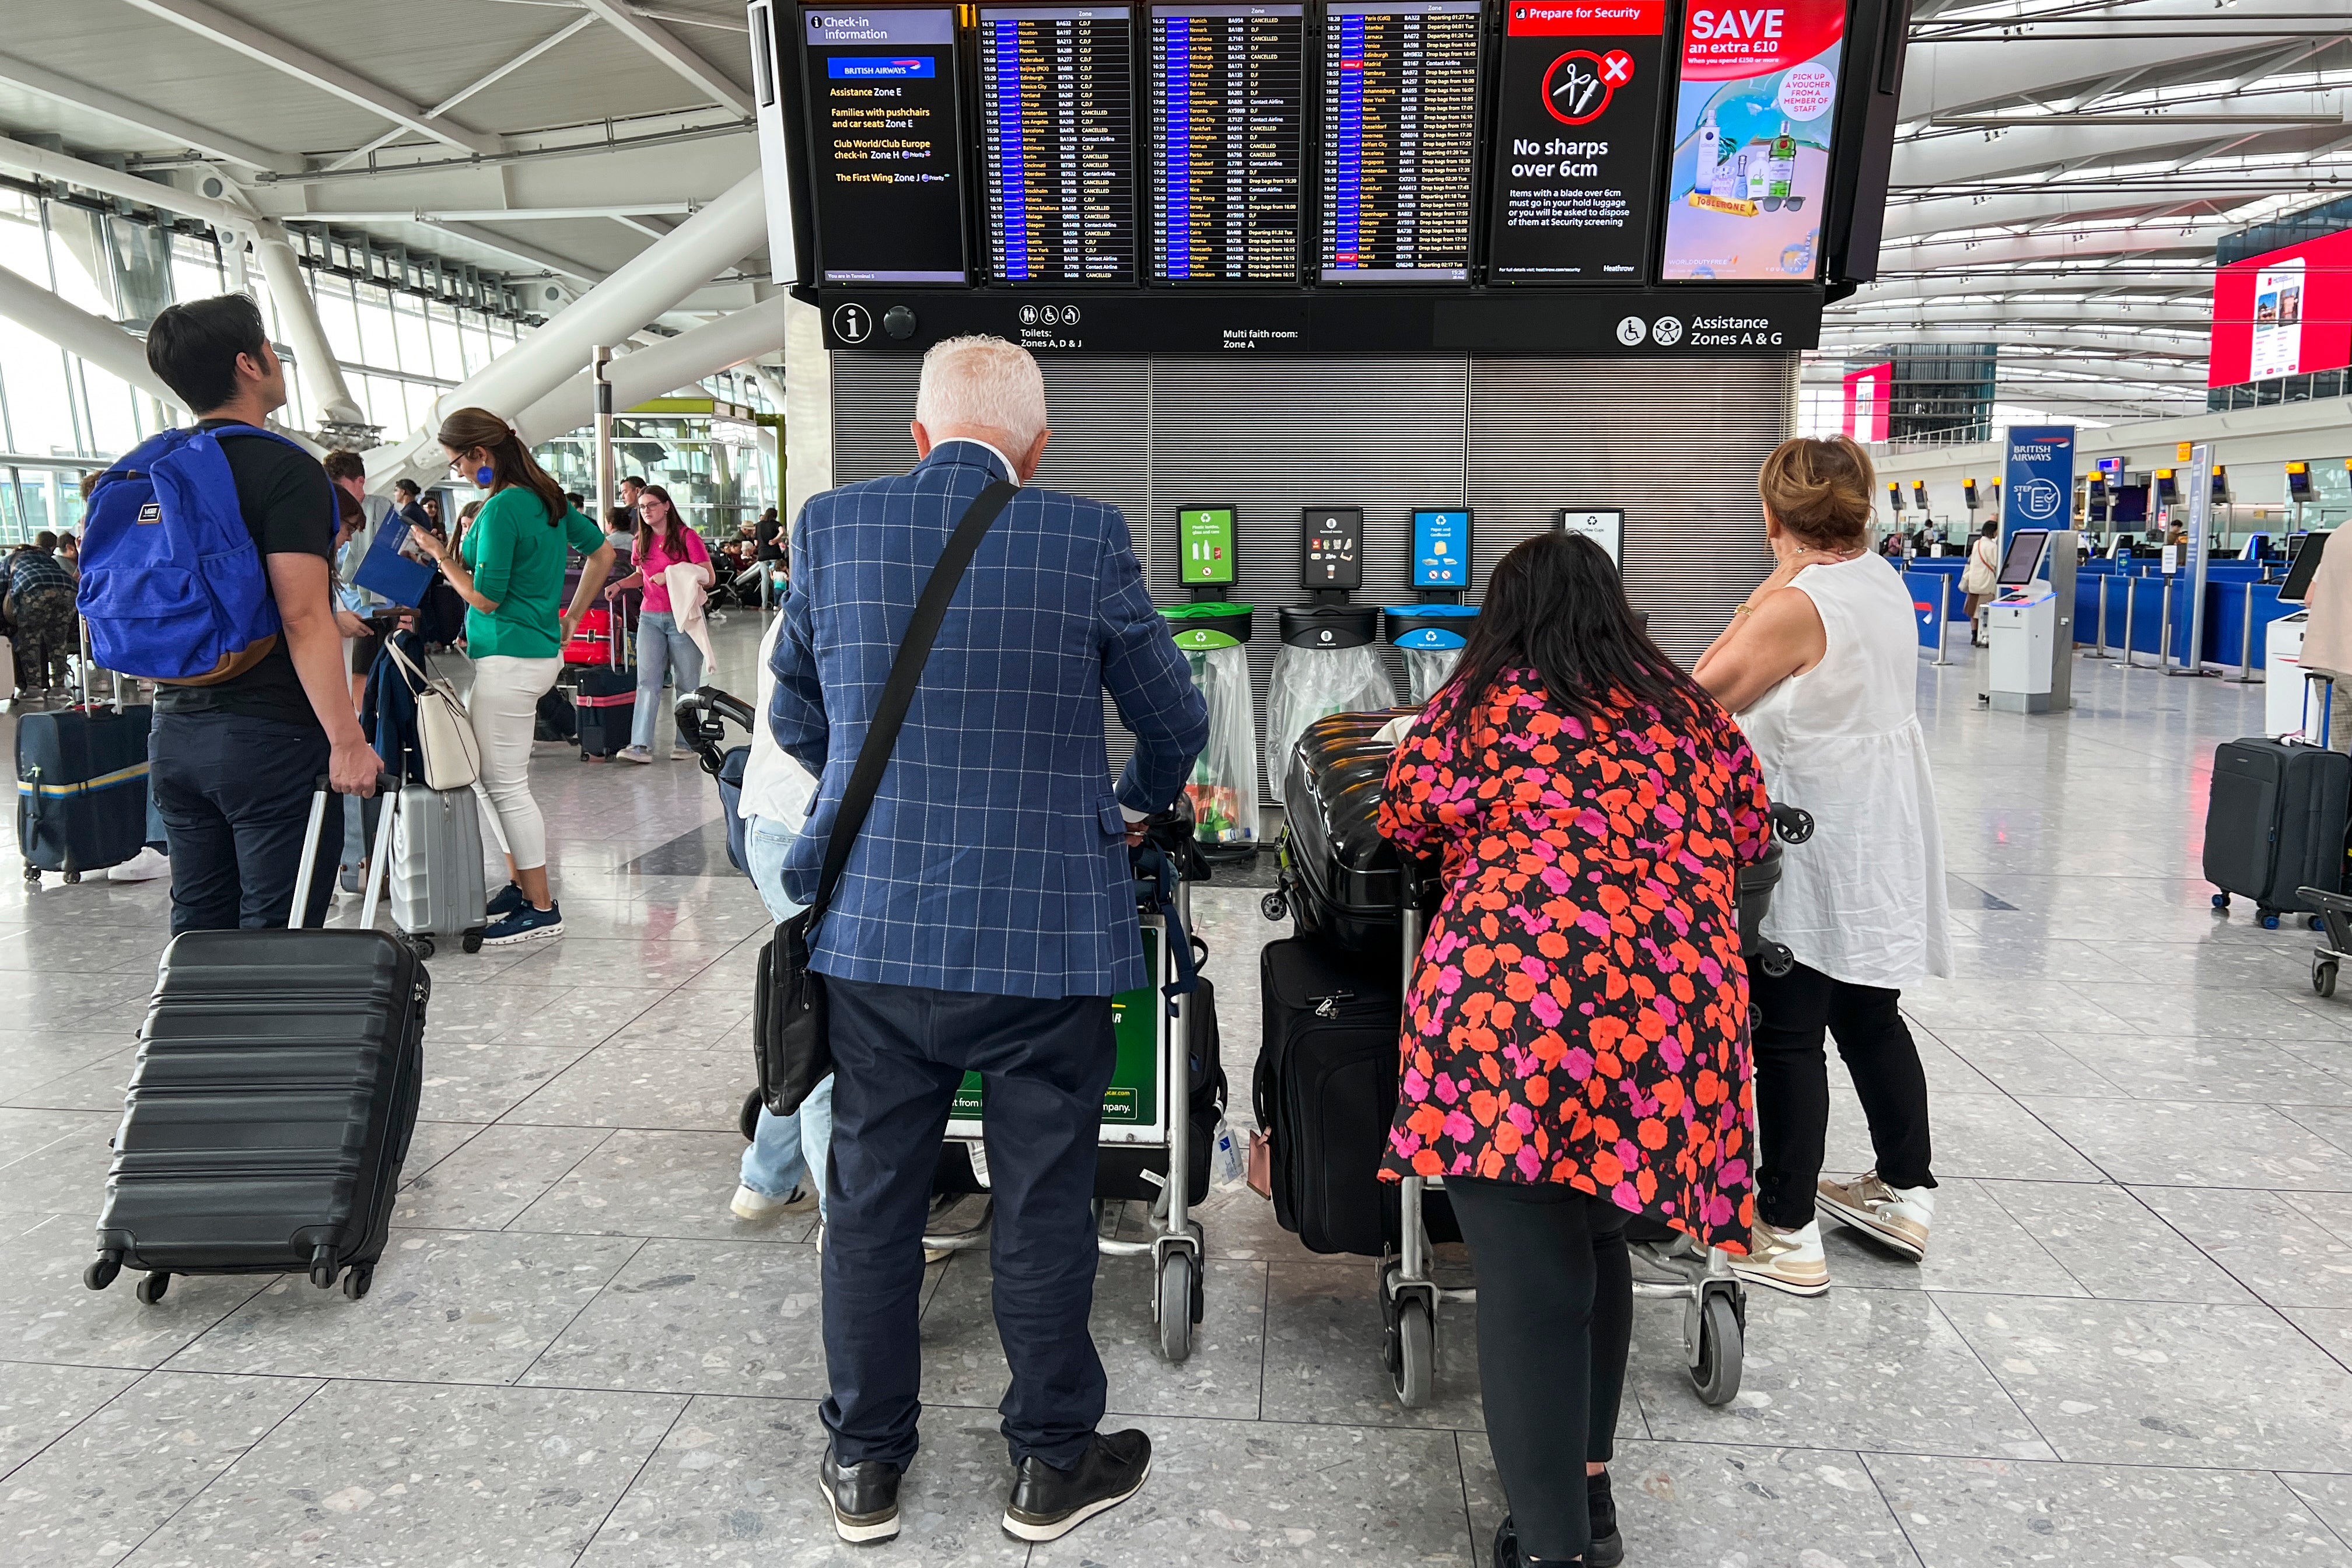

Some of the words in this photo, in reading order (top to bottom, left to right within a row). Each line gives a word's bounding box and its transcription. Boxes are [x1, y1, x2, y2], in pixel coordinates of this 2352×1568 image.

[1530, 8, 1573, 20] Prepare
[1576, 8, 1592, 18] for
[1594, 8, 1640, 19] Security
[824, 17, 869, 27] Check-in
[1691, 9, 1784, 38] SAVE
[825, 30, 887, 39] information
[1689, 43, 1707, 54] an
[1710, 42, 1749, 53] extra
[1753, 41, 1777, 52] £10
[830, 88, 873, 96] Assistance
[874, 88, 894, 96] Zone
[896, 88, 902, 96] E
[832, 108, 864, 117] Families
[866, 108, 885, 117] with
[886, 108, 930, 118] pushchairs
[832, 120, 848, 128] and
[886, 120, 906, 128] Zone
[908, 120, 913, 128] E
[853, 139, 900, 148] World/Club
[901, 140, 930, 149] Europe
[1513, 139, 1540, 155] No
[1545, 138, 1608, 159] sharps
[834, 150, 867, 159] check-in
[1511, 163, 1555, 177] over
[1559, 160, 1598, 177] 6cm
[852, 173, 870, 181] First
[871, 174, 893, 184] Wing
[916, 174, 920, 182] J
[1560, 189, 1583, 197] blade
[1592, 199, 1626, 208] luggage
[1697, 196, 1746, 212] TOBLERONE
[1536, 208, 1550, 216] will
[1563, 208, 1587, 216] asked
[1599, 209, 1629, 217] dispose
[1551, 218, 1583, 227] Security
[1584, 218, 1623, 227] screening
[1692, 316, 1769, 329] Assistance
[1020, 328, 1052, 337] Toilets:
[1223, 330, 1247, 338] Multi
[1249, 330, 1269, 338] faith
[1690, 332, 1737, 345] Zones
[1740, 332, 1753, 345] A
[1755, 333, 1767, 345] &
[1770, 332, 1782, 345] G
[1021, 339, 1047, 347] Zones
[1048, 340, 1058, 348] A,
[1077, 340, 1082, 348] J
[1223, 340, 1245, 348] Zone
[1247, 340, 1255, 348] A
[2014, 445, 2051, 453] BRITISH
[2011, 453, 2052, 461] AIRWAYS
[2017, 492, 2022, 502] 1
[959, 1097, 979, 1107] from
